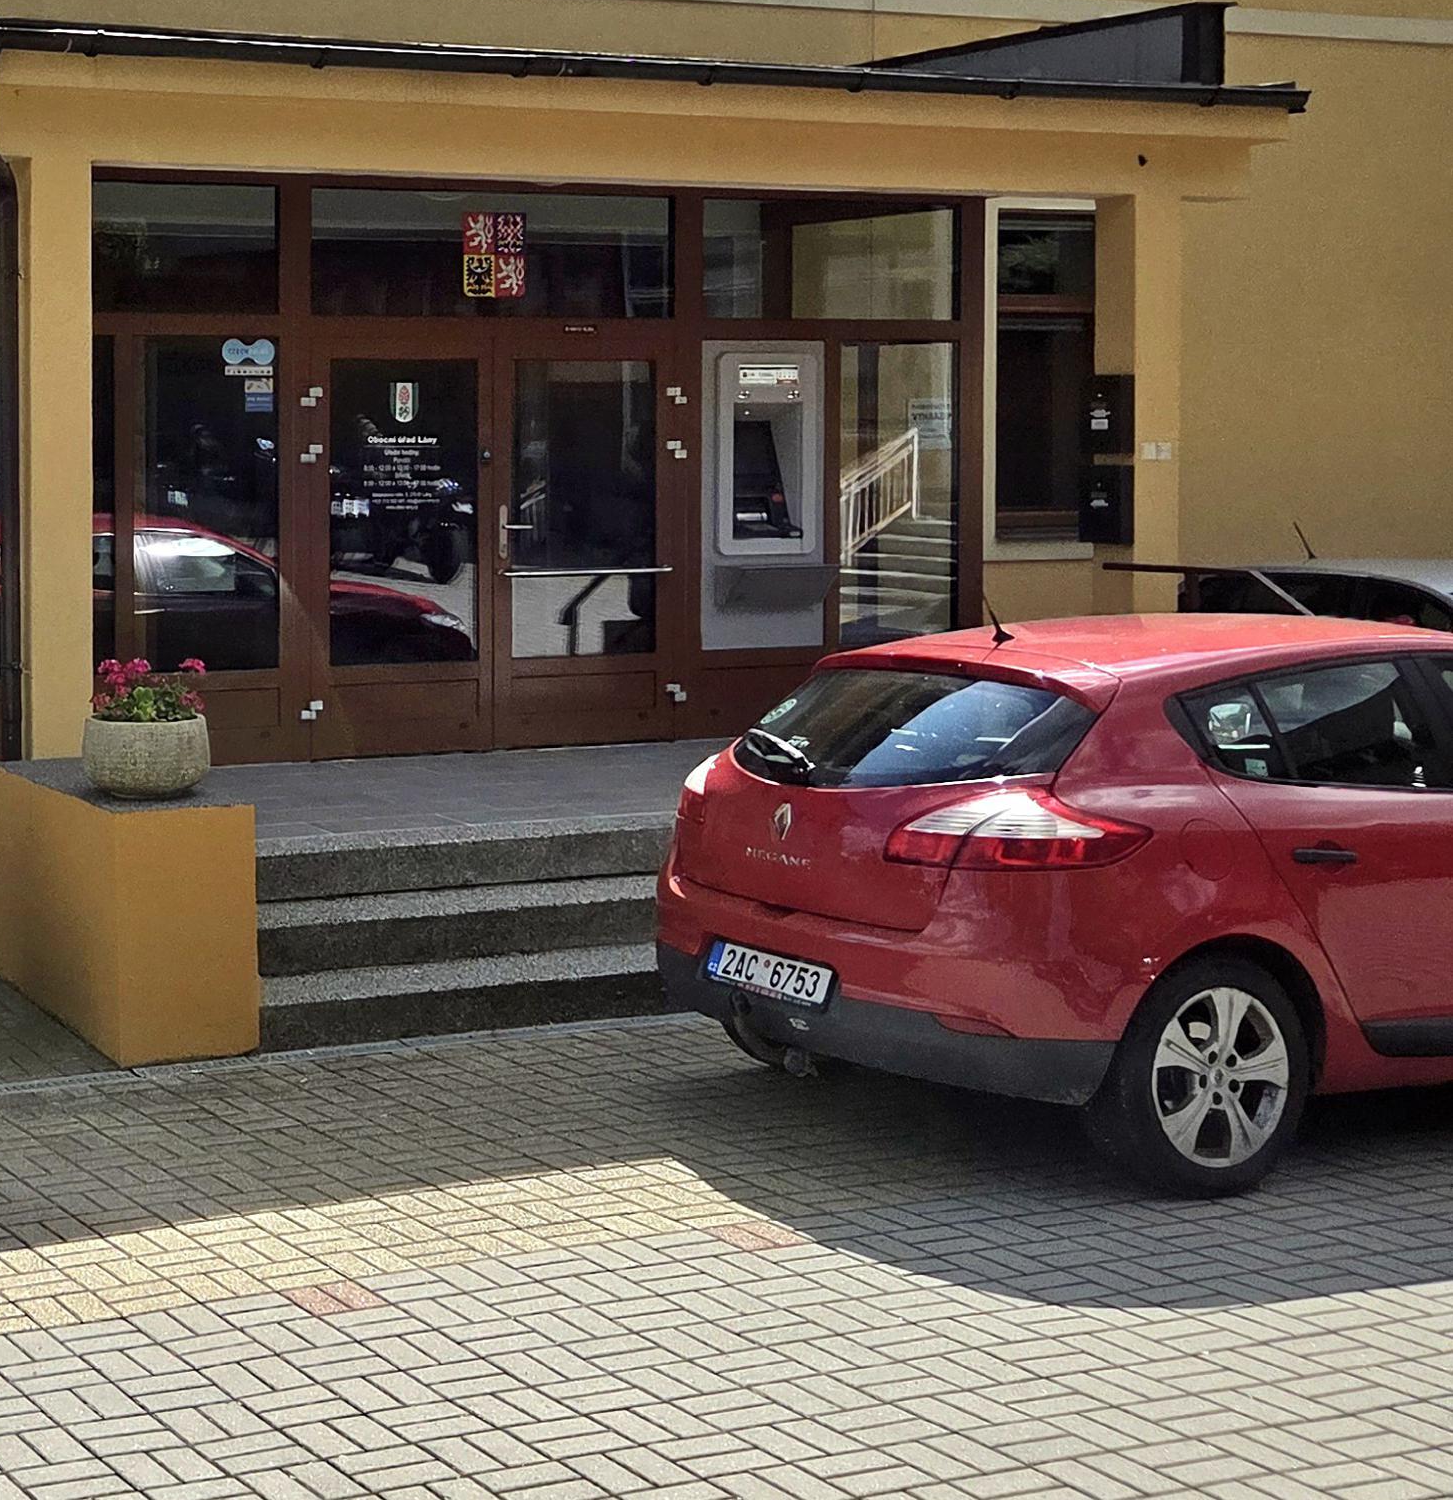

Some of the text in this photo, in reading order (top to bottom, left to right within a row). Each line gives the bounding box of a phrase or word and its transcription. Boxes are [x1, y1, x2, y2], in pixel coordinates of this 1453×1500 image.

[746, 846, 811, 869] MEGANE
[721, 949, 759, 981] 2AC
[769, 961, 821, 998] 6753
